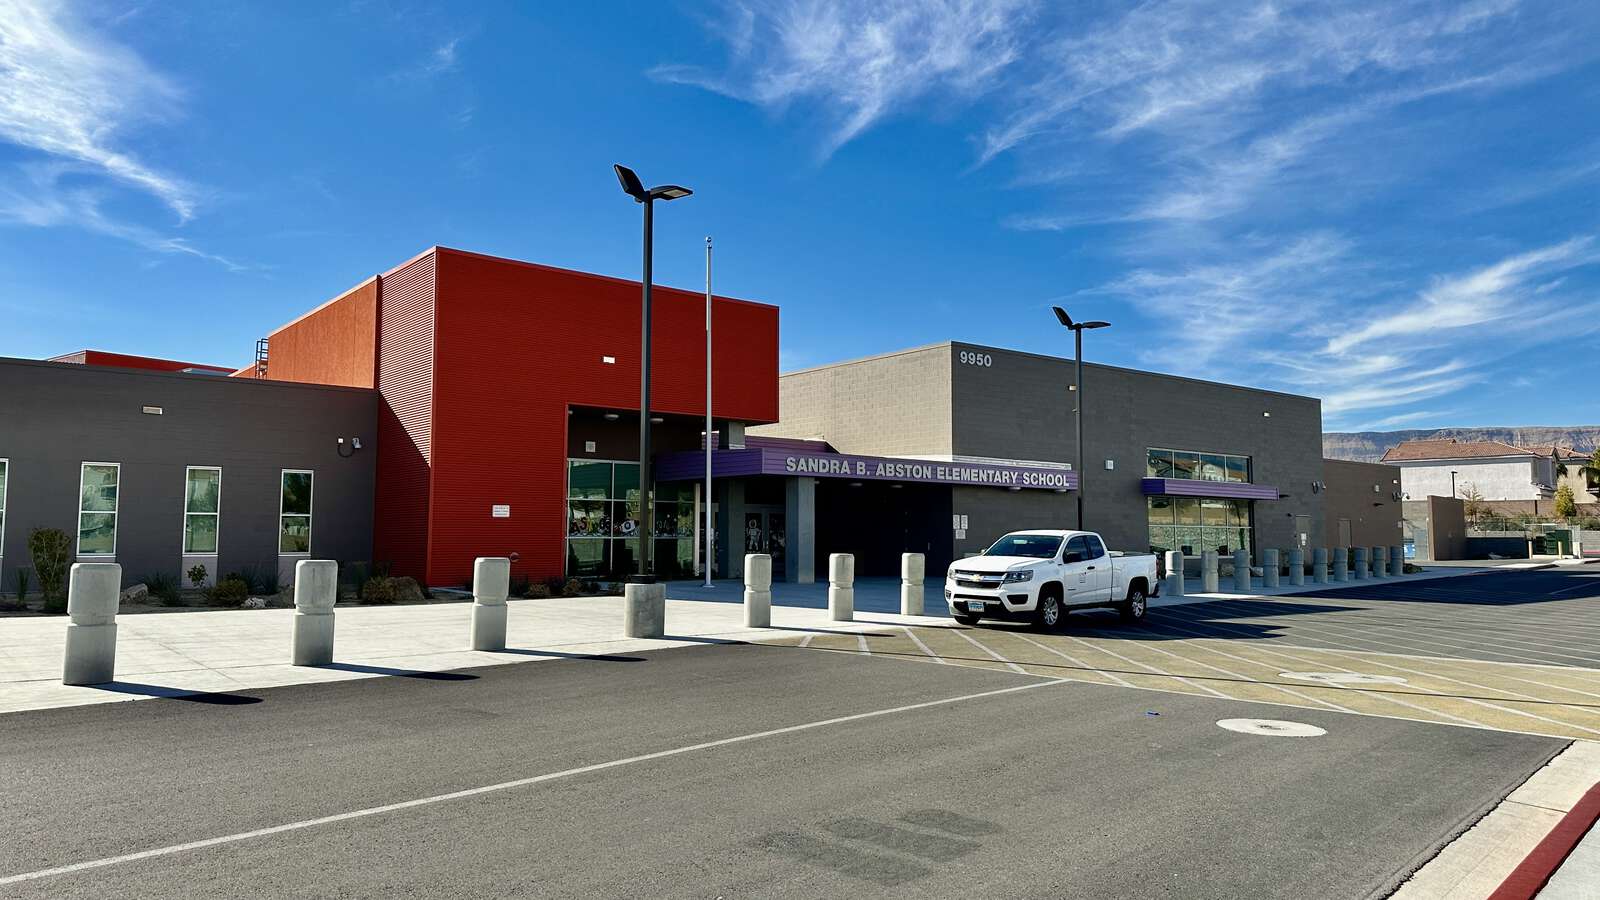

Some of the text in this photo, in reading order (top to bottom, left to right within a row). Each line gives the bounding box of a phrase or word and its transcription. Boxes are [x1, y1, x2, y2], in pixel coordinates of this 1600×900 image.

[960, 351, 992, 367] 9950
[786, 457, 1070, 487] SANDRA B. ABSTON ELEMENTARY SCHOOL
